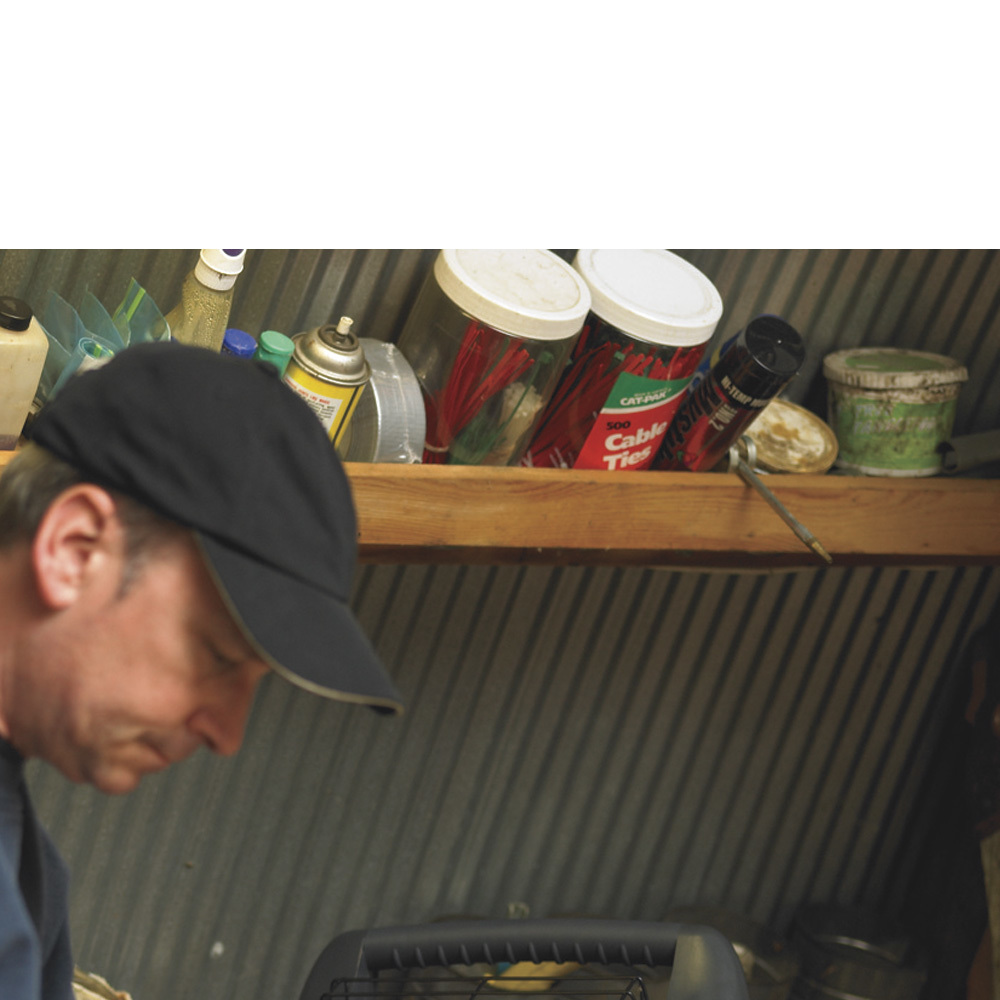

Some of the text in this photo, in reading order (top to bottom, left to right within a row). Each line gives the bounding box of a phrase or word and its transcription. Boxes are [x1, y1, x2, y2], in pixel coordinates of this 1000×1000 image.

[620, 392, 667, 406] CAT-PAK
[721, 376, 753, 405] HI-TEMP
[604, 421, 667, 451] Cable
[606, 421, 631, 430] 500
[603, 445, 652, 471] Ties
